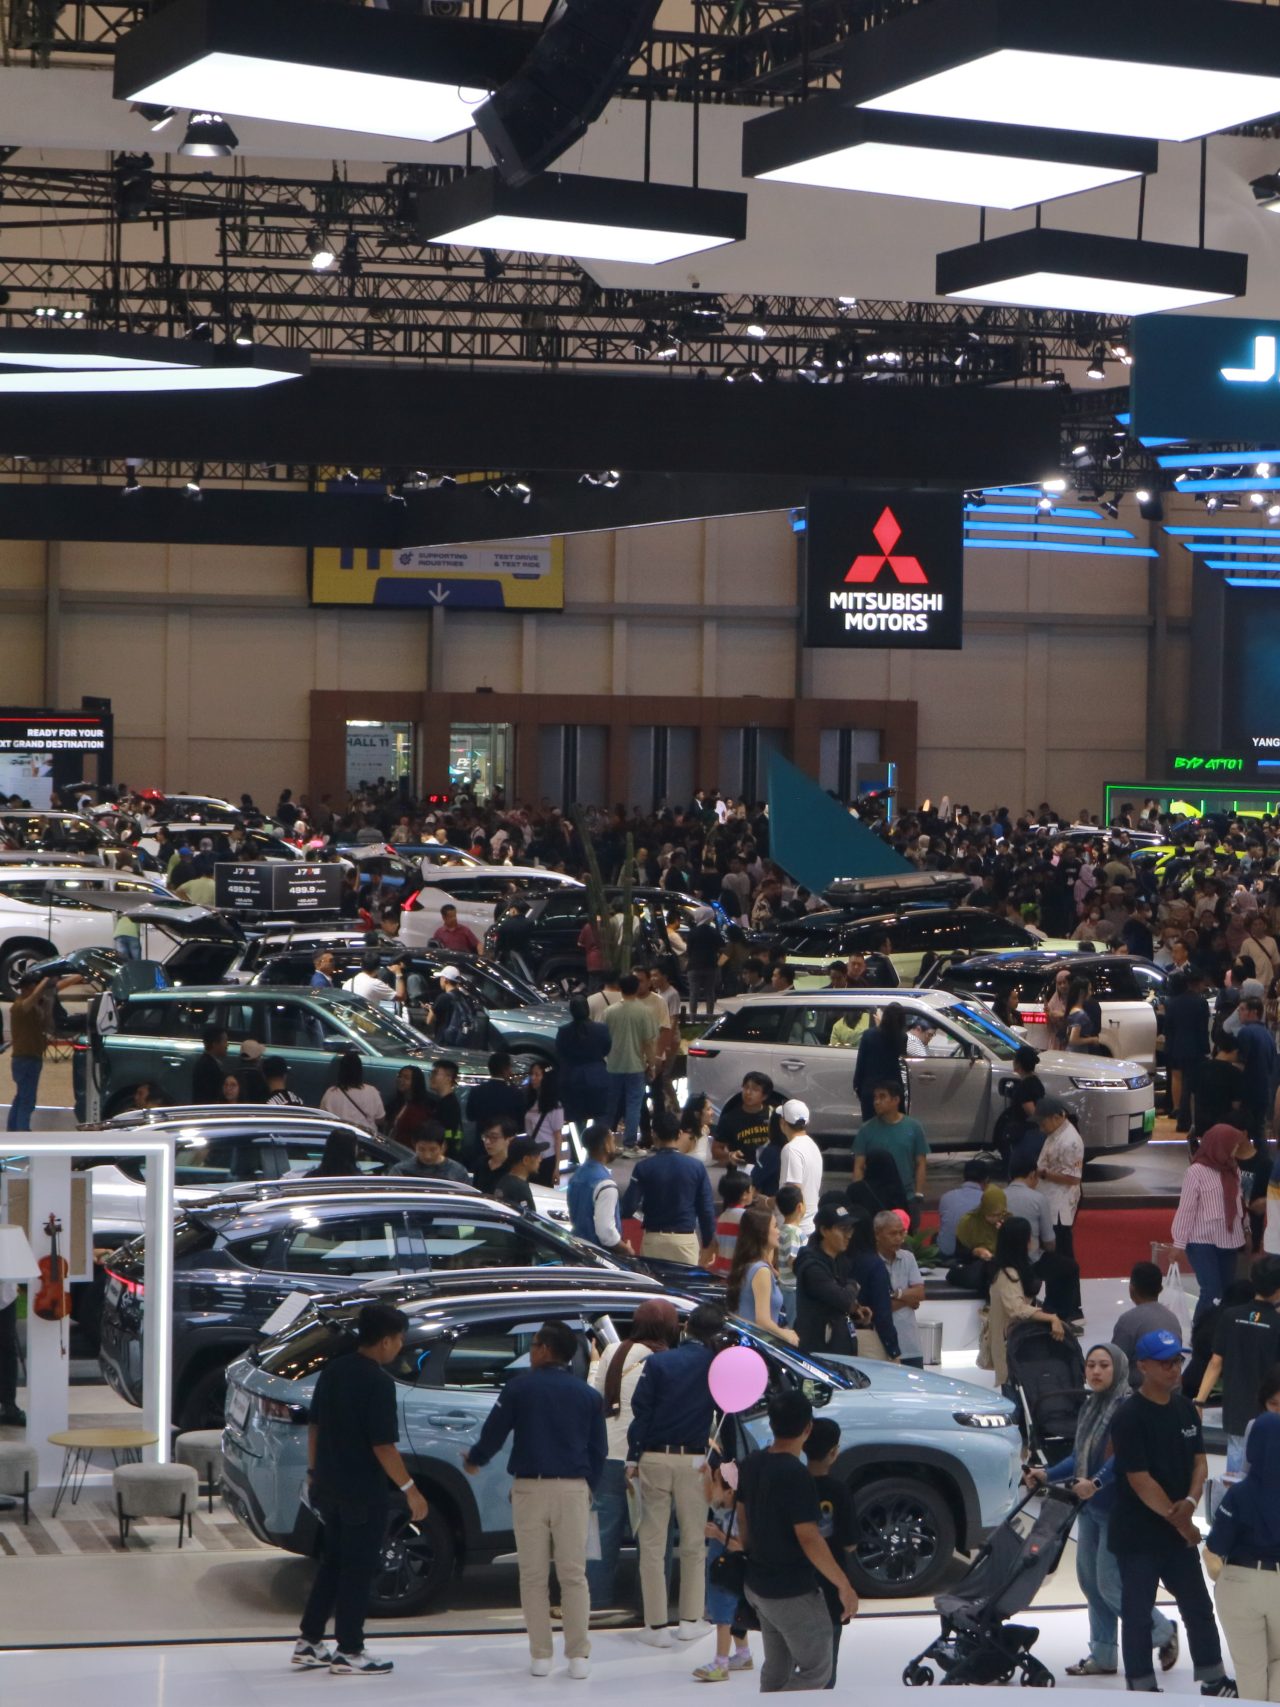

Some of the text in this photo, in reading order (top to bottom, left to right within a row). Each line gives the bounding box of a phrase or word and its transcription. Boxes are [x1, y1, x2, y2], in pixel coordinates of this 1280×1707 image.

[418, 552, 468, 560] SUPPORTING
[514, 554, 539, 562] DRIVE
[829, 592, 943, 611] MITSUBISHI
[845, 613, 929, 631] MOTORS
[27, 729, 104, 738] READY FOR YOUR
[13, 740, 44, 748] GRAND
[46, 741, 104, 749] DESTINATION
[1174, 757, 1204, 769] BYD
